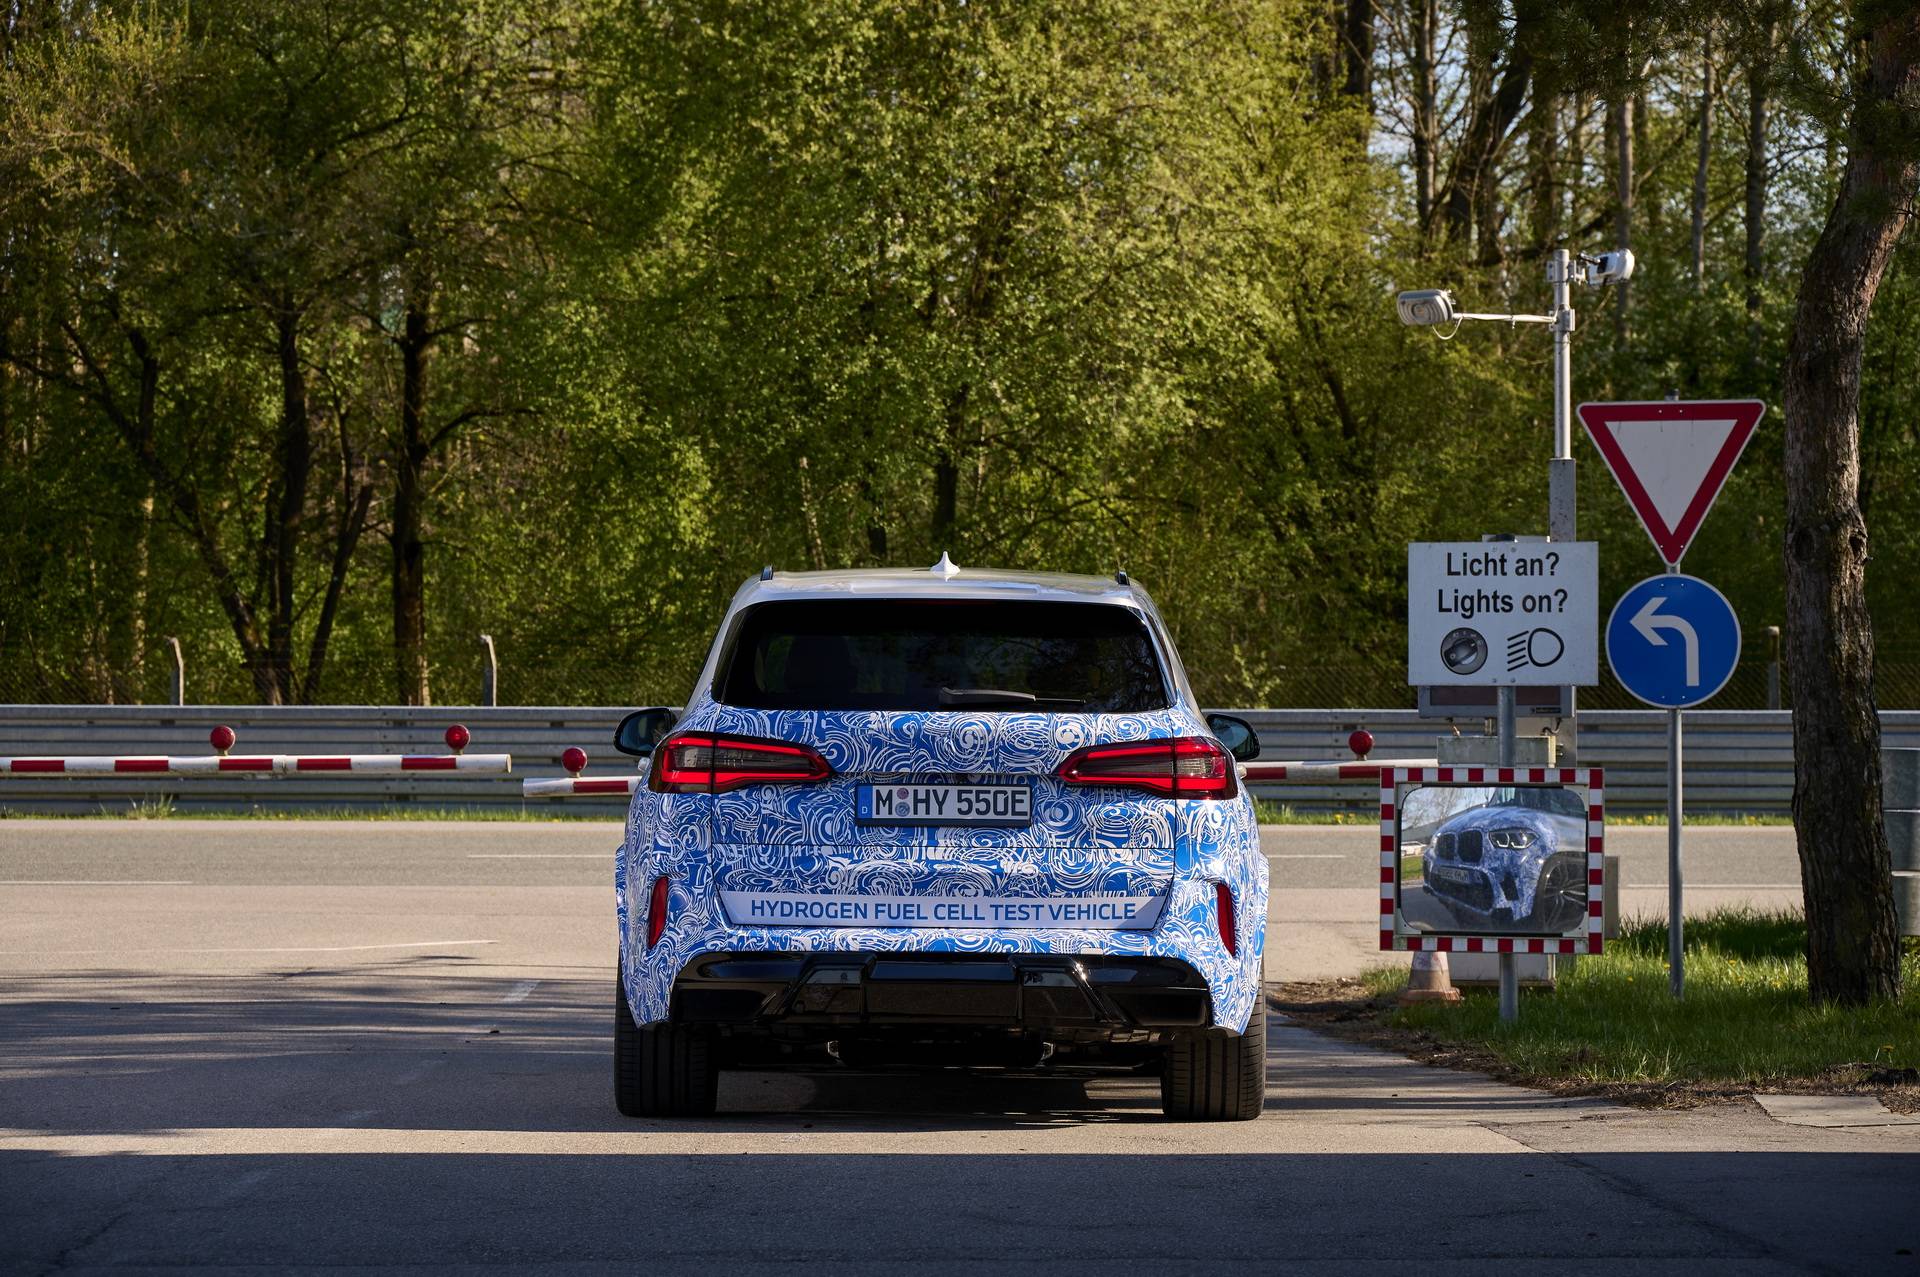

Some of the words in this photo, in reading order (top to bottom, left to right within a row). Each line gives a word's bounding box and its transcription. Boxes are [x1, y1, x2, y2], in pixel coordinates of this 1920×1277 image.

[1447, 552, 1507, 576] Licht
[1515, 552, 1560, 576] an?
[1438, 589, 1513, 619] Lights
[1522, 588, 1568, 612] on?
[875, 789, 893, 816] M
[913, 789, 949, 816] HY
[957, 789, 1028, 816] 550E
[751, 899, 868, 920] HYDROGEN
[874, 902, 928, 921] FUEL
[934, 903, 985, 921] CELL
[990, 903, 1045, 921] TEST
[1047, 902, 1136, 921] VEHICLE
